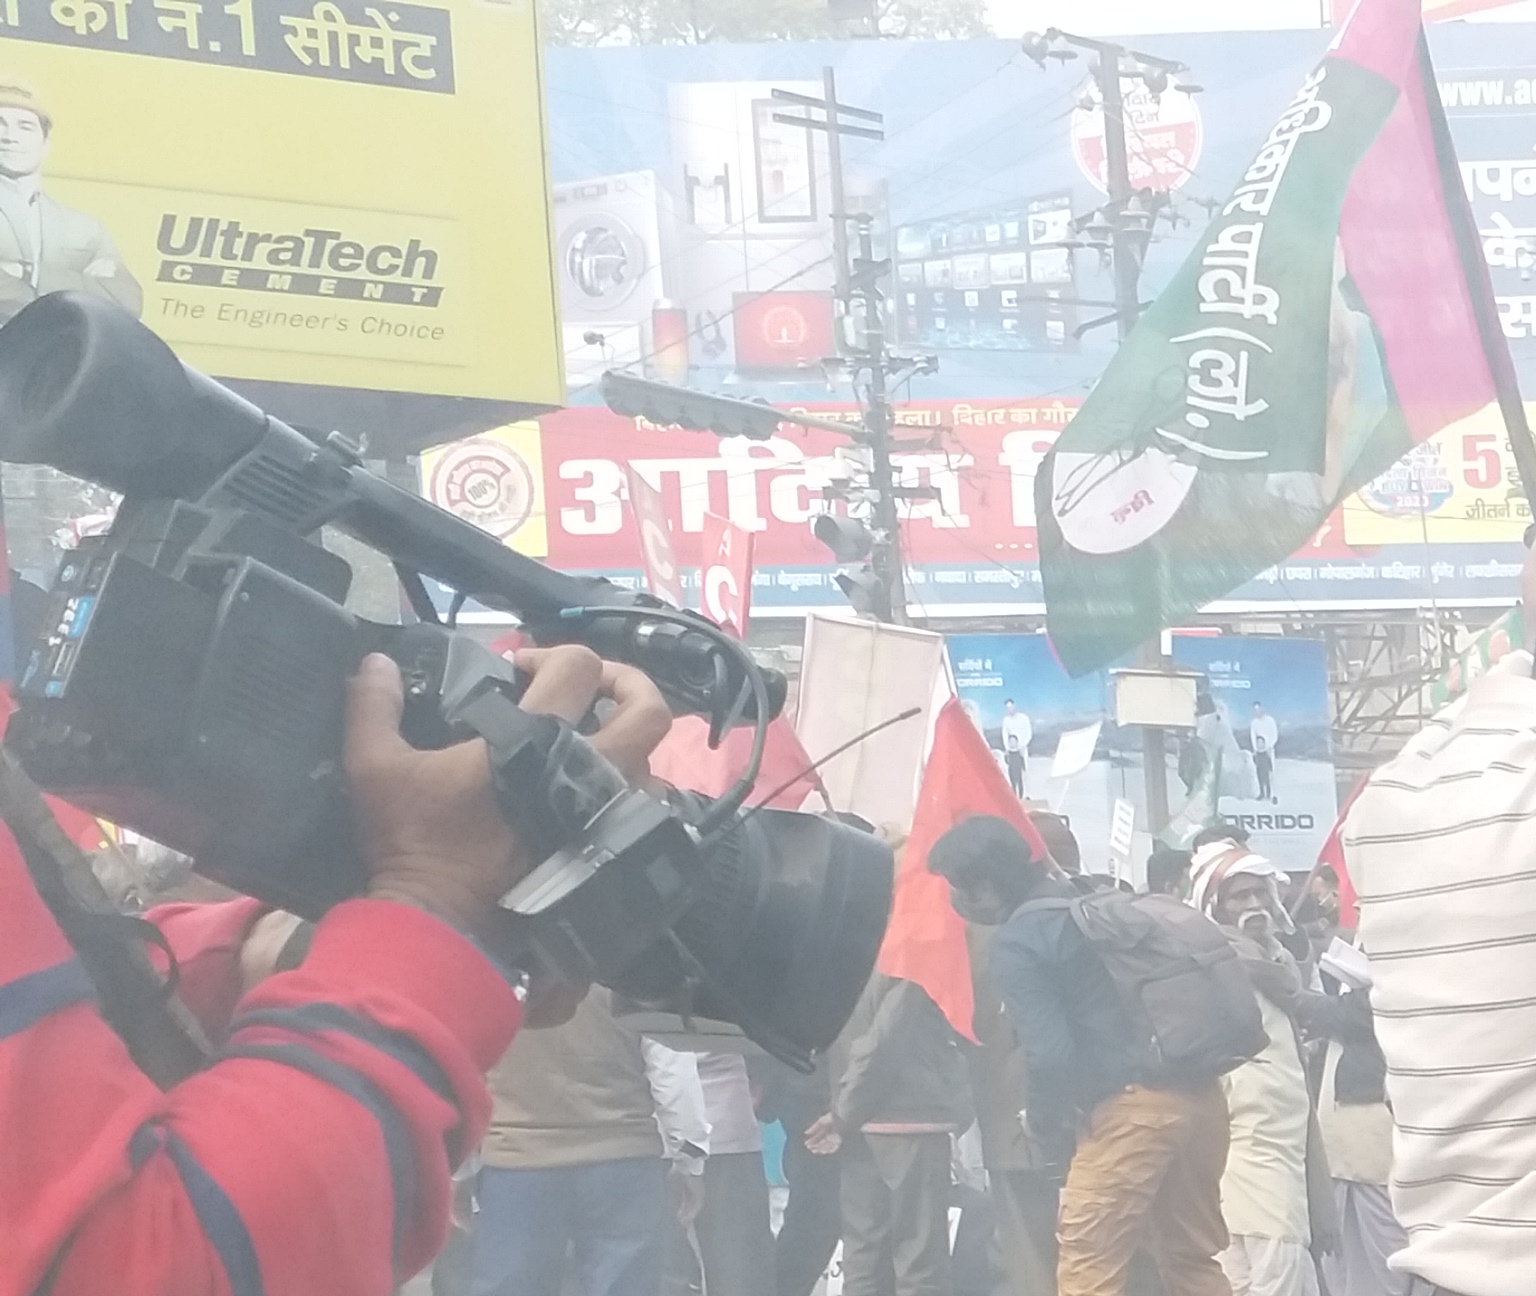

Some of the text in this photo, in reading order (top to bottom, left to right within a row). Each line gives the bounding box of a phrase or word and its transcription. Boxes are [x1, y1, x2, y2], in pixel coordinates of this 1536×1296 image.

[280, 8, 437, 79] सीमेंट
[156, 213, 440, 281] UltraTech
[172, 264, 429, 303] CEMENT
[1198, 222, 1281, 326] पार्टी
[160, 297, 446, 342] The Engineer's Choice
[951, 403, 1004, 426] बिहार
[1008, 408, 1037, 426] का
[1462, 434, 1502, 489] 5
[1465, 498, 1511, 520] जीतने
